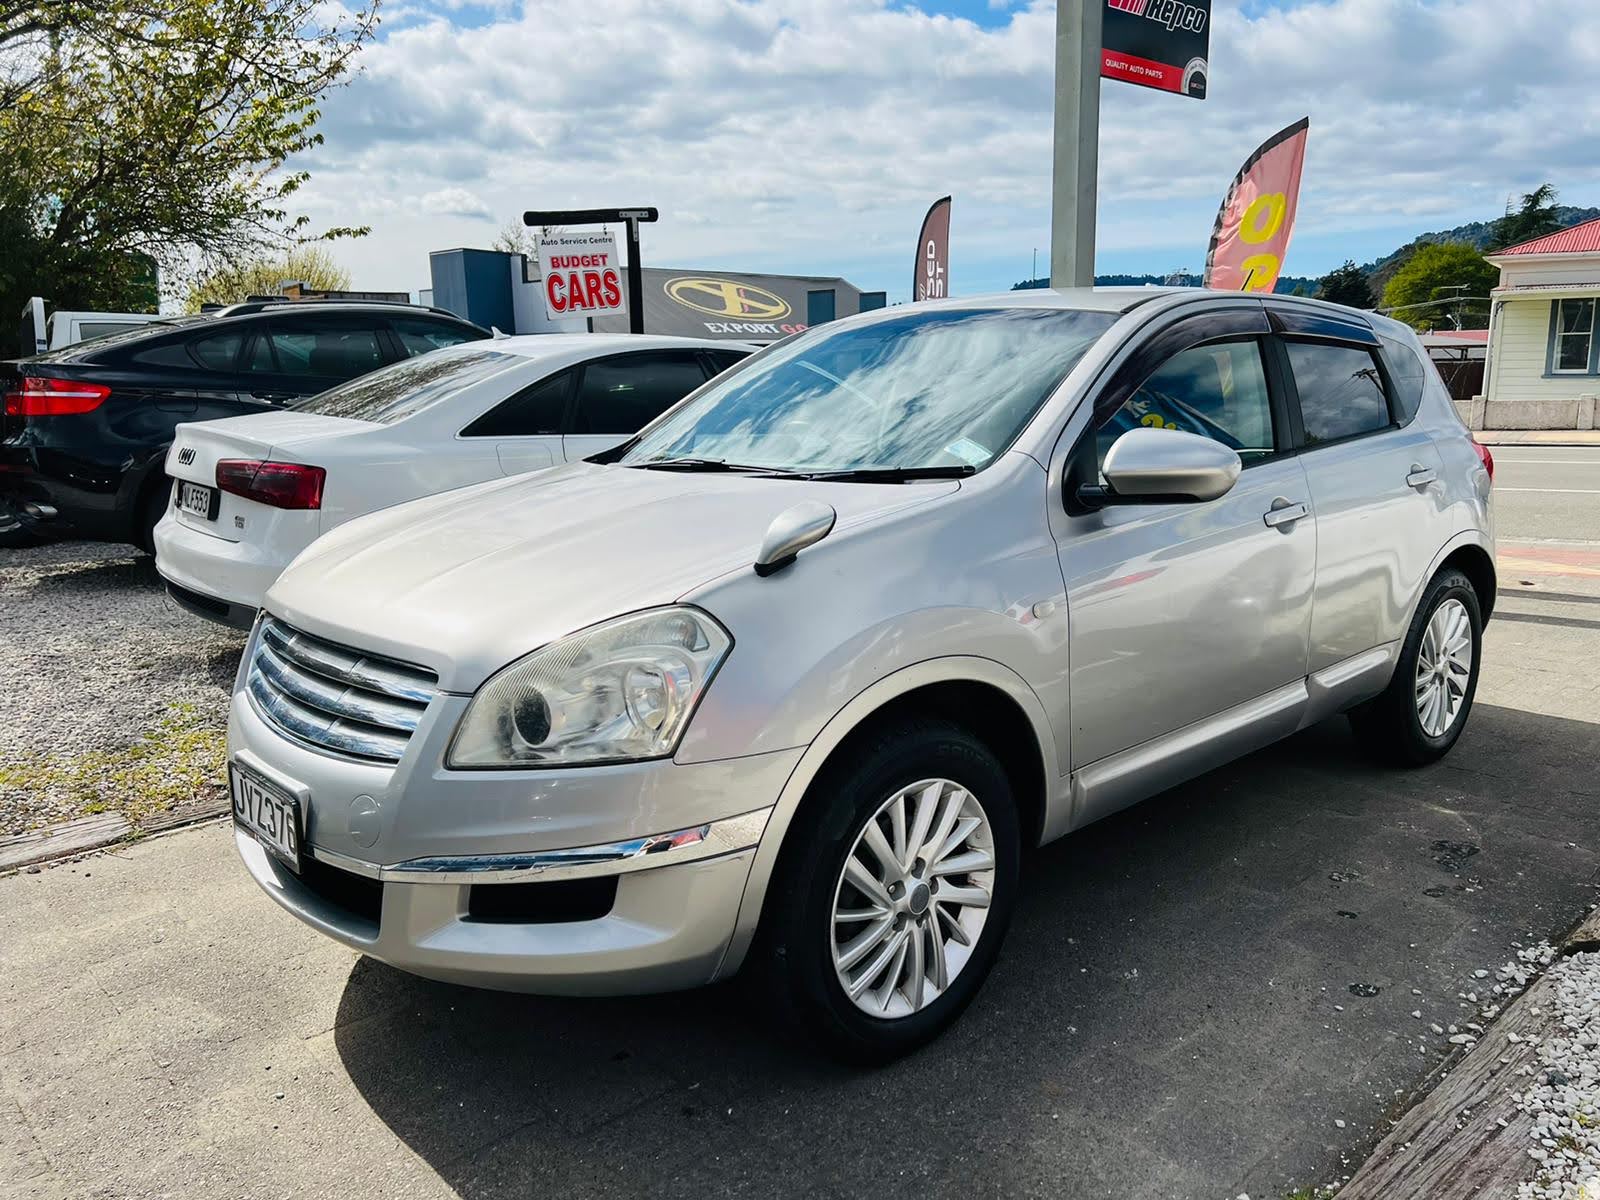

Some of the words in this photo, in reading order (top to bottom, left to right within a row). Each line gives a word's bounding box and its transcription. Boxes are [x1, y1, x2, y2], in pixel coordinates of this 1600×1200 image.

[1146, 0, 1207, 33] Repco
[1105, 59, 1129, 71] QUALITY
[1129, 65, 1144, 75] AUTO
[1145, 68, 1163, 79] PARTS
[560, 237, 588, 245] Service
[588, 236, 613, 244] Centre
[1239, 192, 1286, 293] OP
[550, 252, 609, 270] BUDGET
[546, 268, 621, 313] CARS
[704, 322, 780, 334] EXPORT
[236, 778, 297, 856] JYZ376
